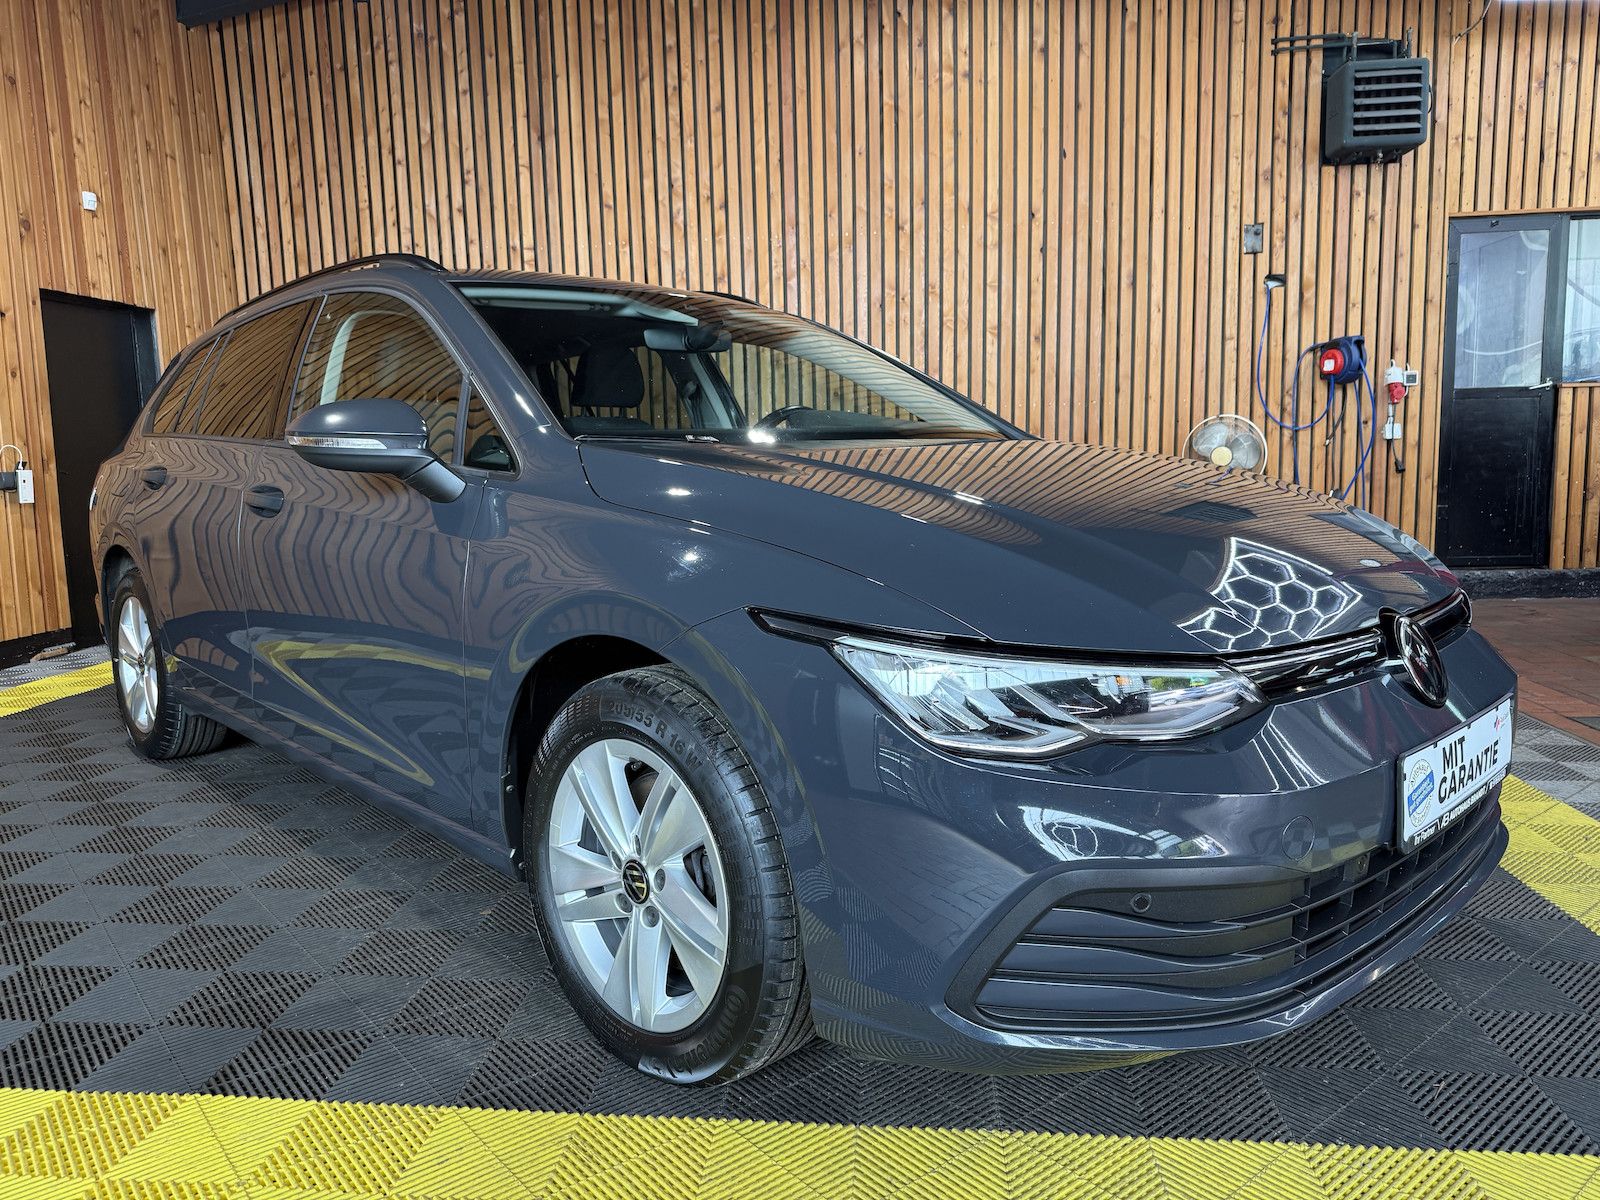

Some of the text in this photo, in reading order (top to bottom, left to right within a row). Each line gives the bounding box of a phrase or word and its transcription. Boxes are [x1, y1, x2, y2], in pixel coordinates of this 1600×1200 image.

[609, 701, 654, 728] 205/55
[656, 722, 668, 739] R
[669, 734, 685, 754] 16
[1438, 739, 1499, 804] GARANTIE
[1442, 736, 1466, 774] MIT
